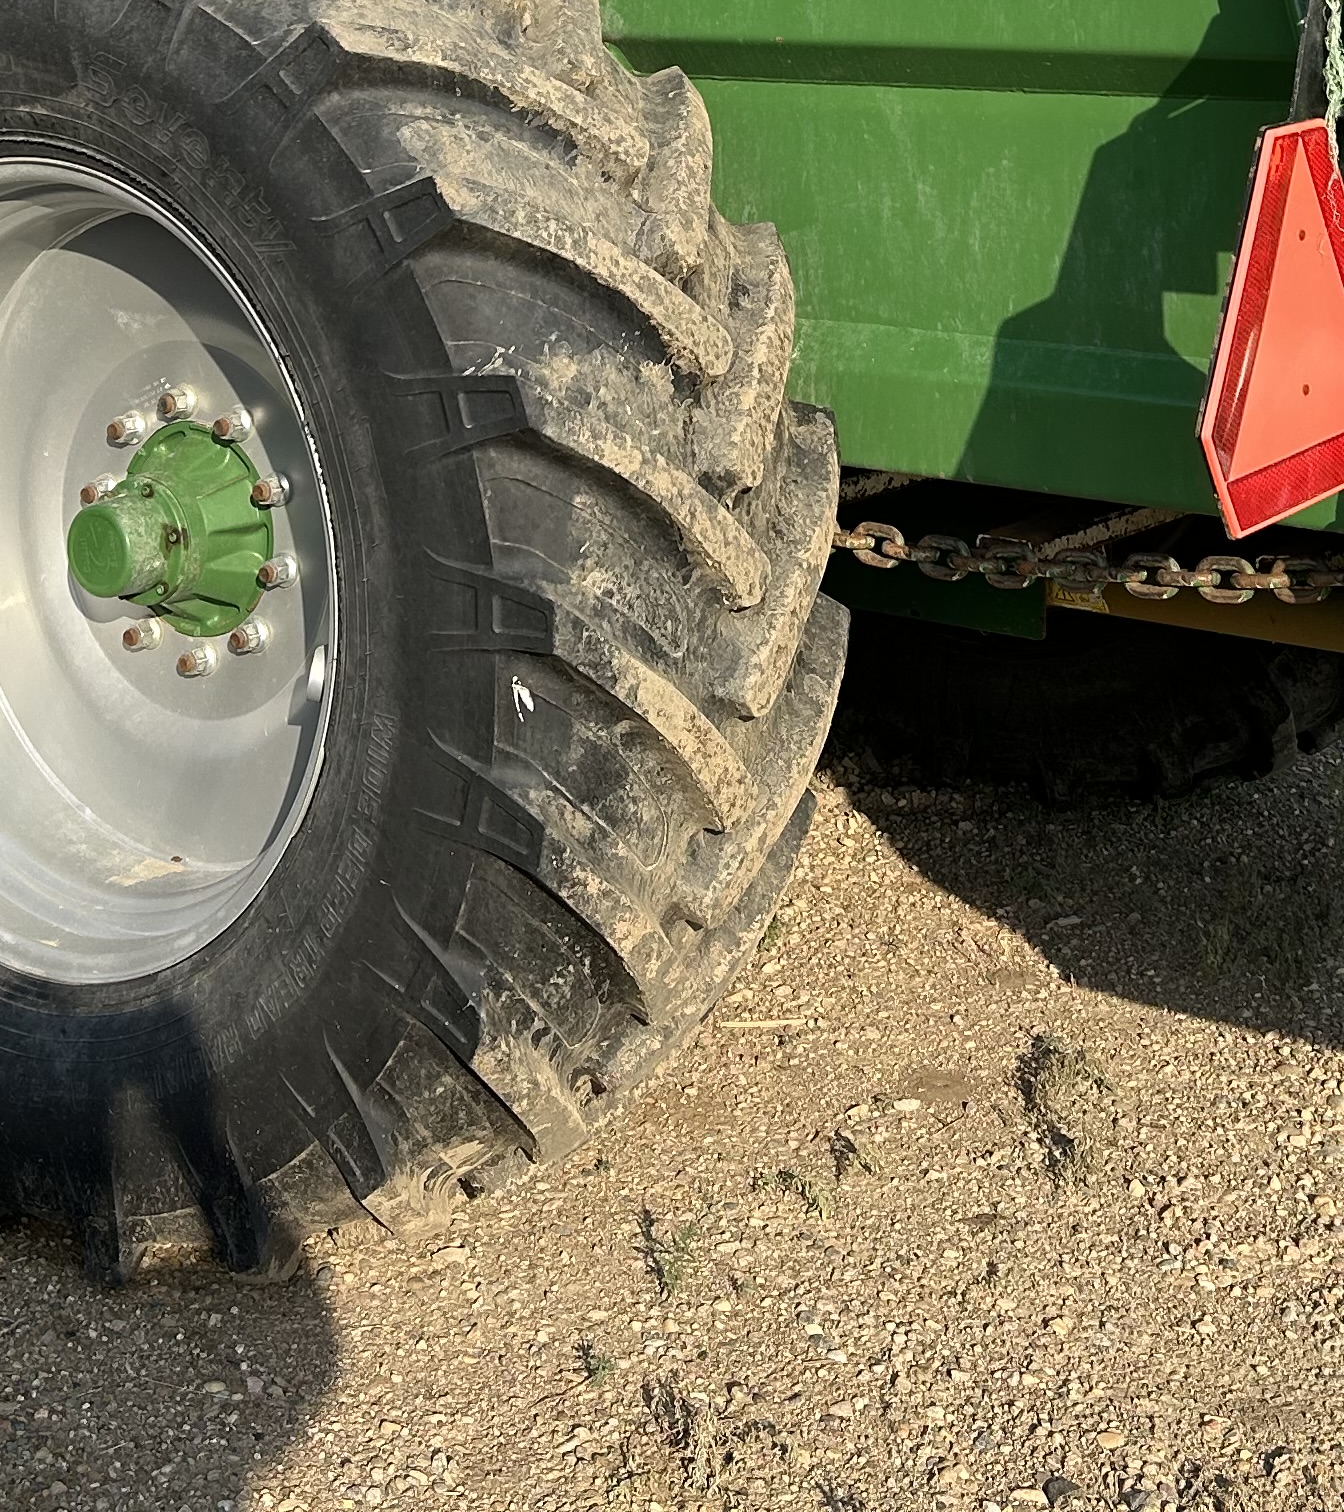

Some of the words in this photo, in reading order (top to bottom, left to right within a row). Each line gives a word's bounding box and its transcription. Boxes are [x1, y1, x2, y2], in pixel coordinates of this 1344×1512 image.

[354, 712, 398, 825] WIDE
[313, 823, 373, 941] DEEP
[242, 933, 324, 1042] TREAD
